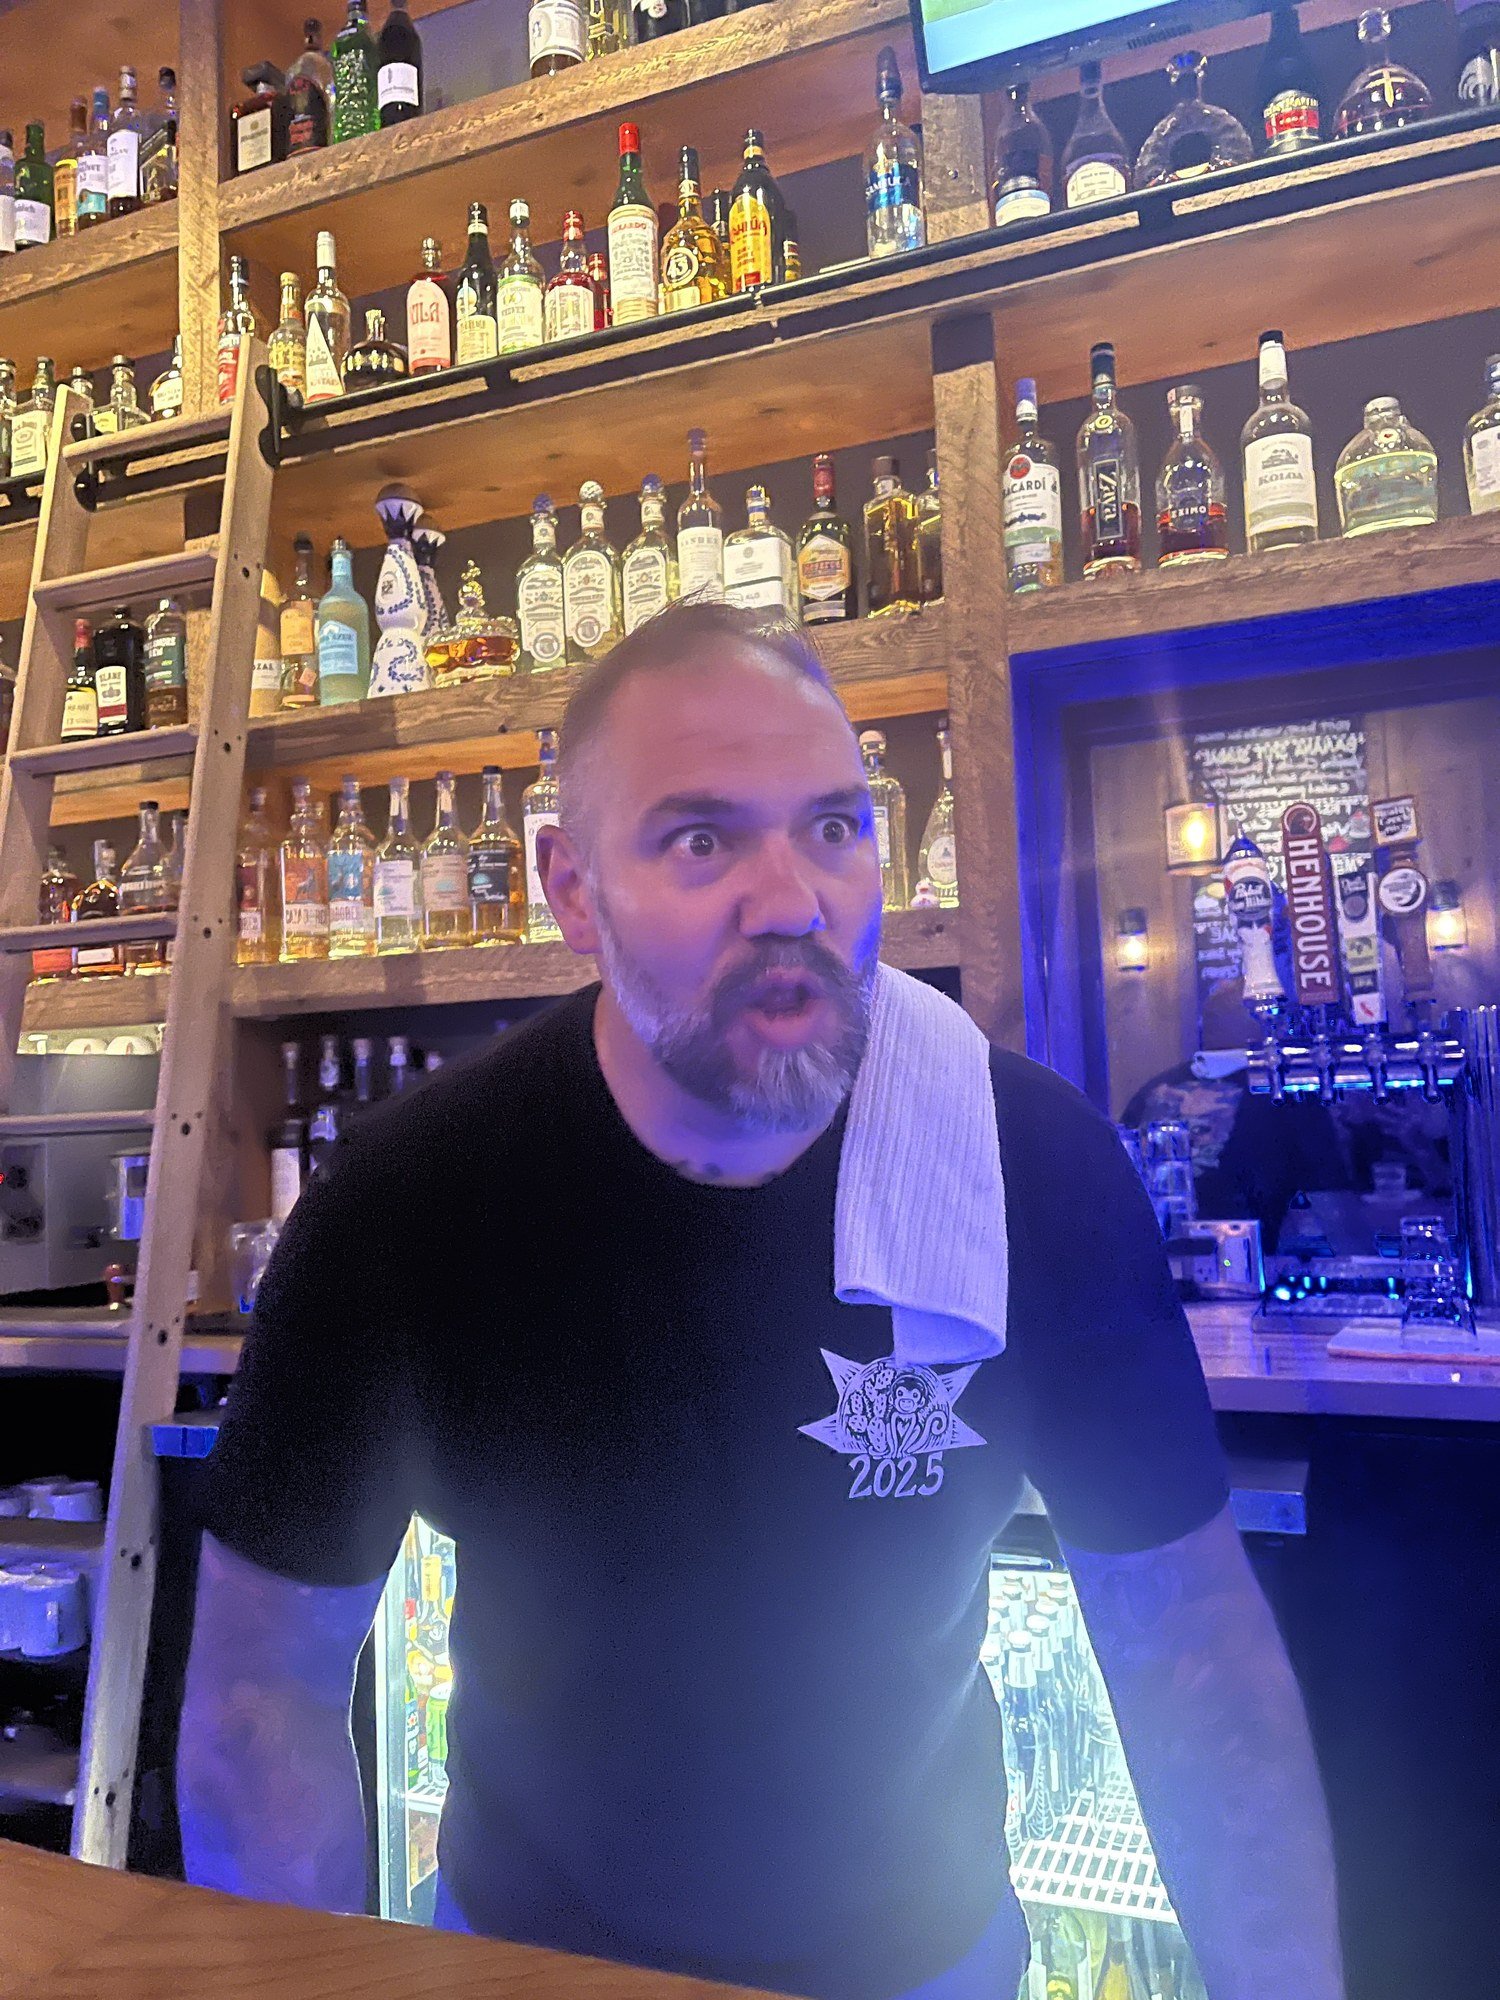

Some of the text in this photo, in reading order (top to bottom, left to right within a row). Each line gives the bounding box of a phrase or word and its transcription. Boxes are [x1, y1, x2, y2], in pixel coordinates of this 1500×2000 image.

[252, 662, 274, 671] OZAL
[1289, 838, 1331, 989] HENHOUSE
[849, 1451, 944, 1498] 2025
